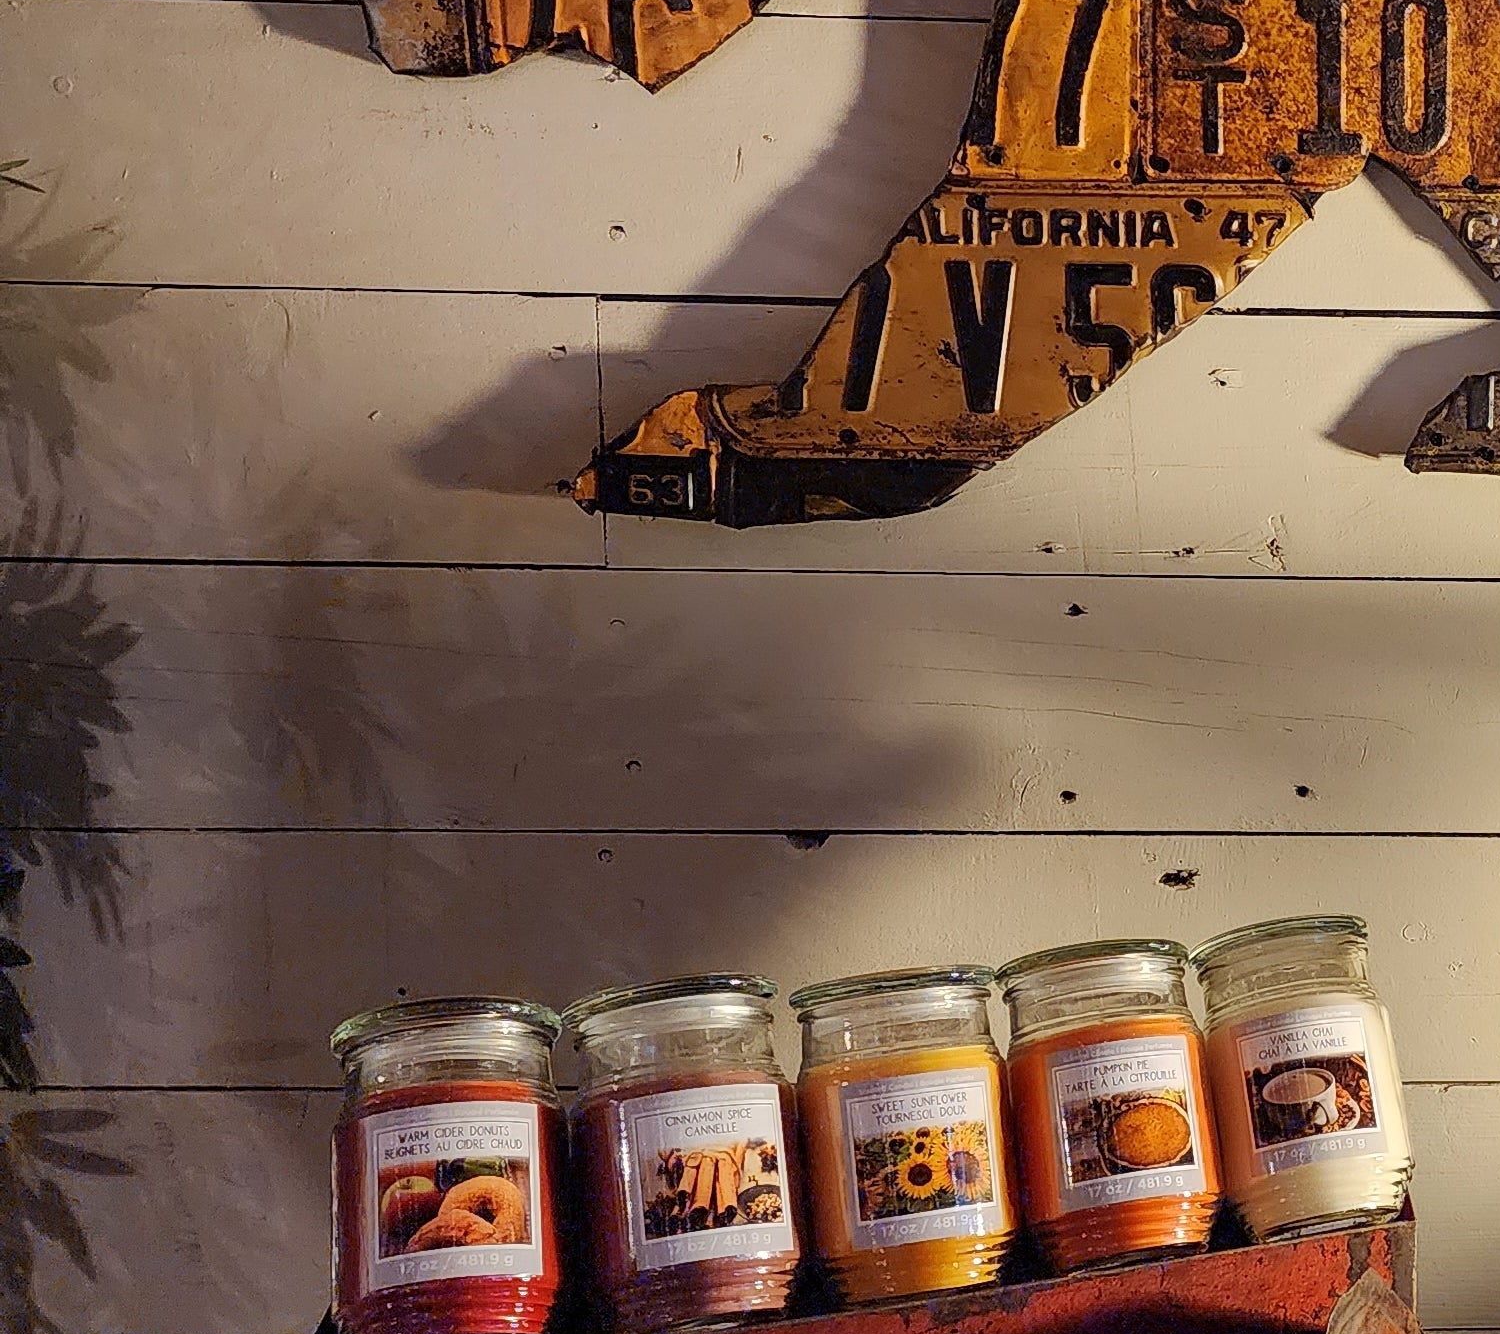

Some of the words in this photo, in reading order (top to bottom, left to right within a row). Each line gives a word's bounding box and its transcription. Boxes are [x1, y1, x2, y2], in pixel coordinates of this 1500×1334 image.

[1269, 1030, 1308, 1046] VANILLA
[1312, 1027, 1334, 1038] CHAI
[1296, 1042, 1309, 1053] LA
[1312, 1036, 1348, 1049] VANILLE
[1093, 1061, 1133, 1077] PUMPKIN
[1137, 1059, 1149, 1070] PIE
[1065, 1079, 1097, 1095] TARTE
[1101, 1076, 1109, 1088] À
[1112, 1075, 1125, 1086] LA
[1129, 1069, 1178, 1083] CITROUILLE
[871, 1100, 905, 1115] SWEET
[911, 1091, 968, 1109] SUNFLOWER
[665, 1111, 723, 1127] CINNAMON
[727, 1108, 753, 1120] SPICE
[876, 1110, 935, 1126] TOURNESOL
[939, 1105, 967, 1117] DOUX
[398, 1131, 430, 1144] WARM
[434, 1127, 465, 1139] CIDER
[469, 1125, 510, 1137] DONUTS
[684, 1122, 738, 1138] CANNELLE
[384, 1144, 431, 1160] BEIGNETS
[435, 1141, 450, 1153] AU
[456, 1139, 485, 1150] CIDRE
[490, 1138, 523, 1150] CHAUD
[1320, 1138, 1354, 1152] 481.9
[1357, 1138, 1366, 1149] g
[1138, 1175, 1173, 1190] 481.9
[1175, 1175, 1184, 1187] g
[723, 1232, 760, 1246] 481.9
[763, 1233, 772, 1245] g
[420, 1261, 439, 1272] oz
[458, 1252, 500, 1267] 481.9
[503, 1253, 514, 1267] g
